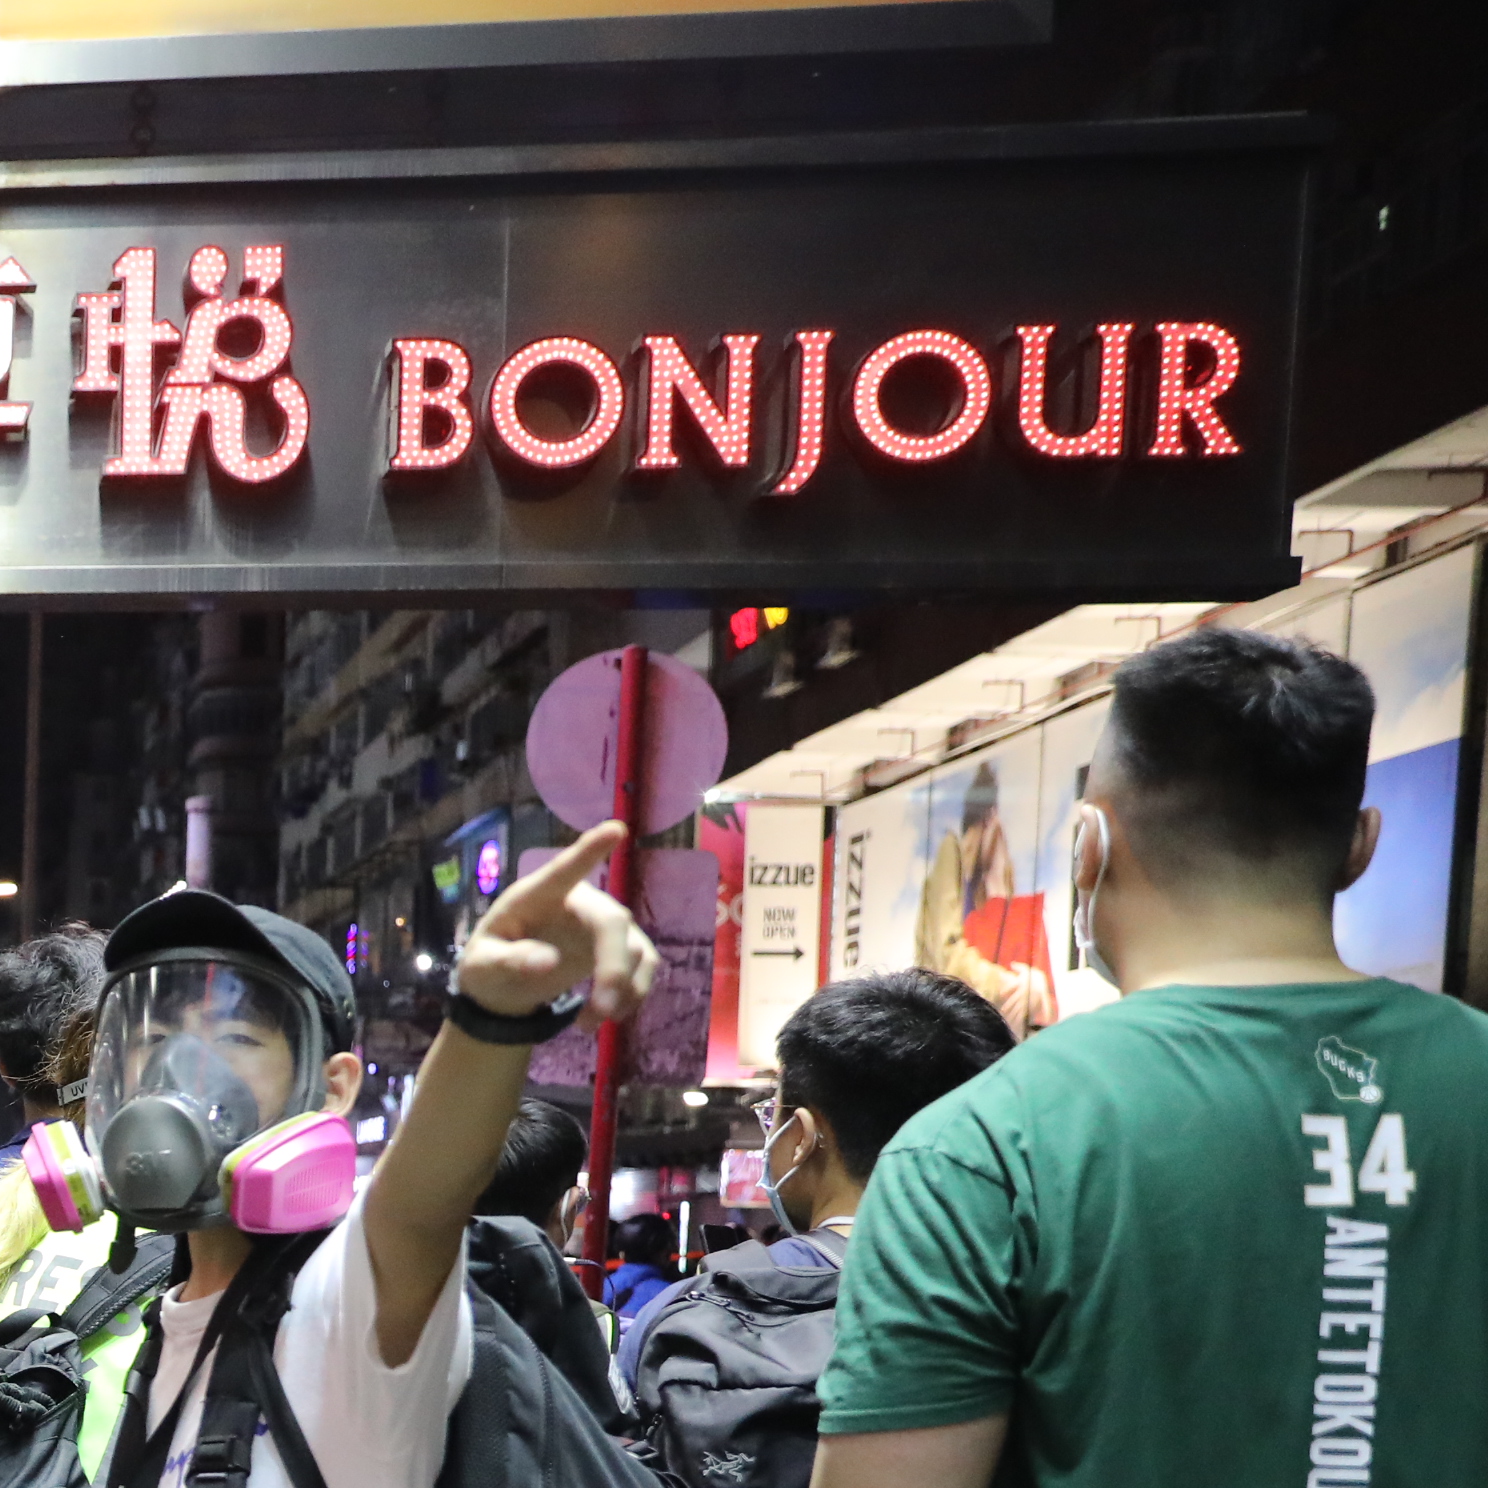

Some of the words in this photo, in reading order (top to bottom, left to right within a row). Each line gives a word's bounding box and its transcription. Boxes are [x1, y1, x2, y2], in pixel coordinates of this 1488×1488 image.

[390, 320, 1243, 496] BONJOUR
[749, 855, 815, 886] izzue
[762, 907, 796, 922] NOW
[843, 829, 872, 968] izzue
[762, 925, 796, 939] OPEN
[1323, 1049, 1365, 1083] BUCKS
[1300, 1113, 1417, 1207] 34
